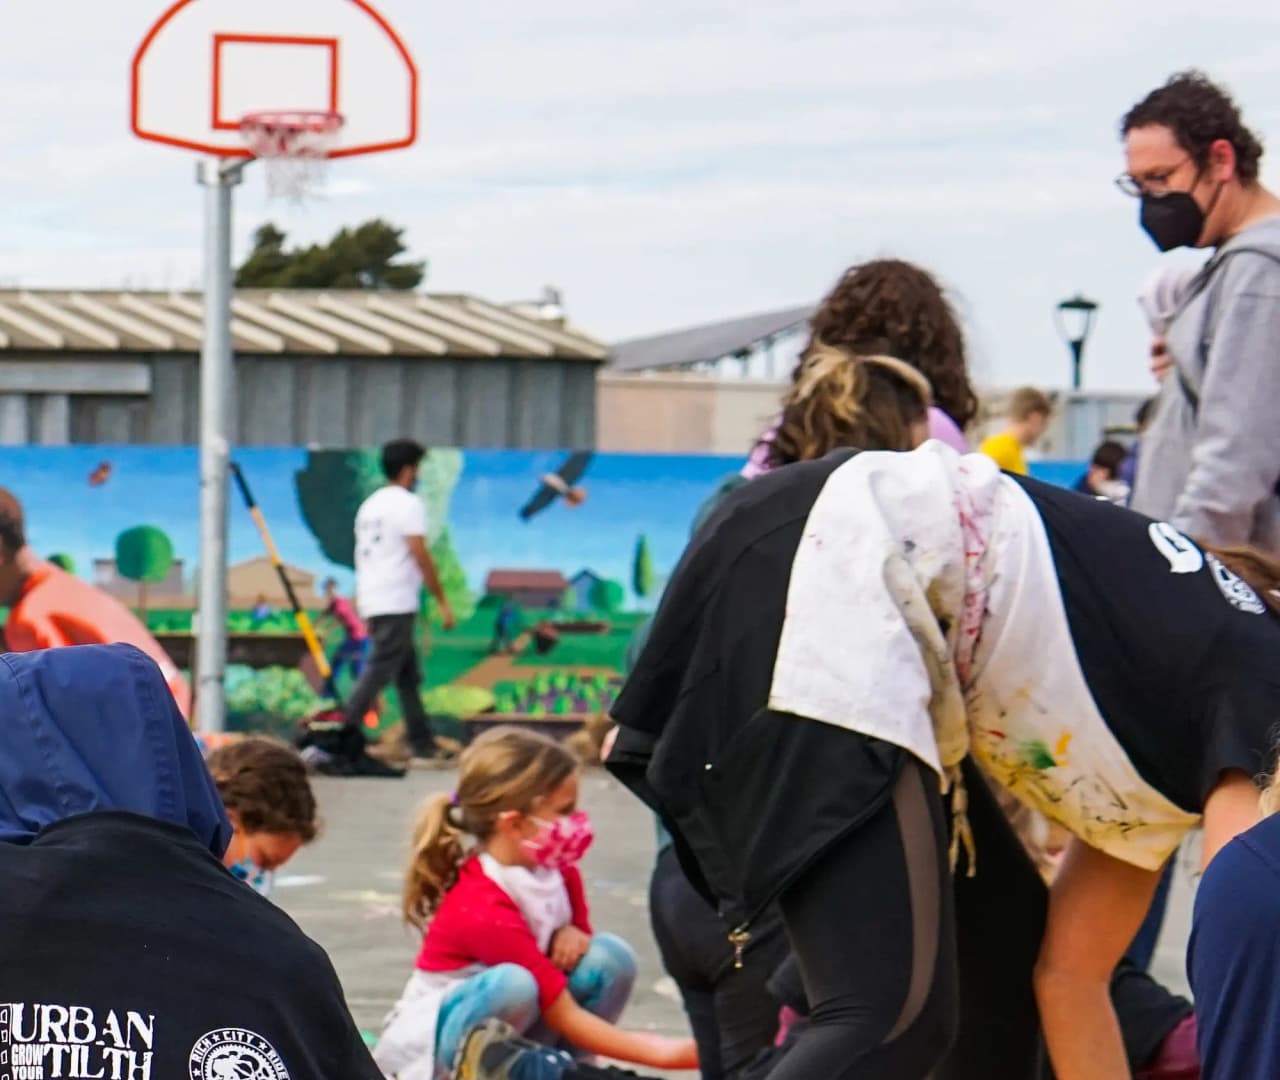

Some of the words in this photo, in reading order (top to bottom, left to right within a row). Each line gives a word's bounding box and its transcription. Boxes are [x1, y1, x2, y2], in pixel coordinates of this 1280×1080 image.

[11, 1002, 155, 1050] URBAN
[11, 1043, 44, 1066] GROW
[192, 1038, 213, 1062] RICH
[222, 1031, 254, 1044] CITY
[11, 1066, 44, 1080] YOUR
